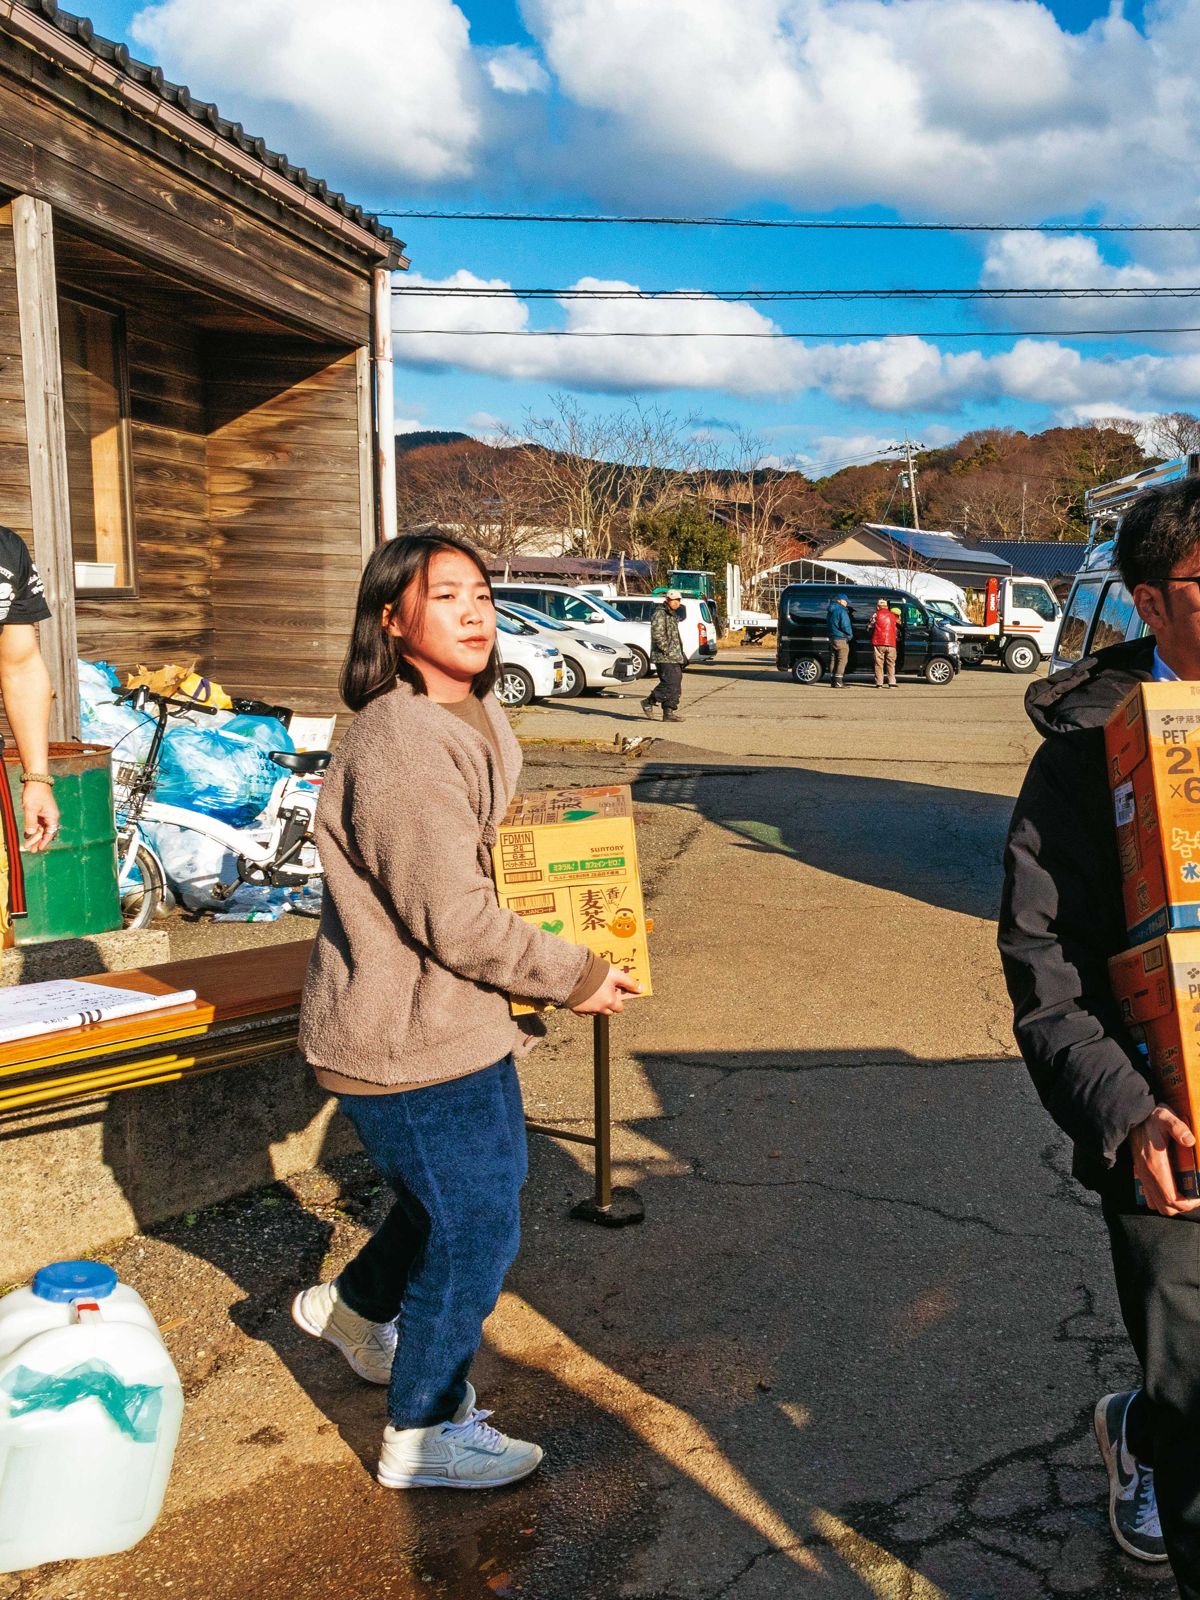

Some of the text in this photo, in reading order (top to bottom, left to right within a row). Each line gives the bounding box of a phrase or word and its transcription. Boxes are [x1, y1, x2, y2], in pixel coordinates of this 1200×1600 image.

[1163, 730, 1188, 744] PET
[590, 845, 624, 853] SUNTORY
[579, 890, 606, 932] 麦茶
